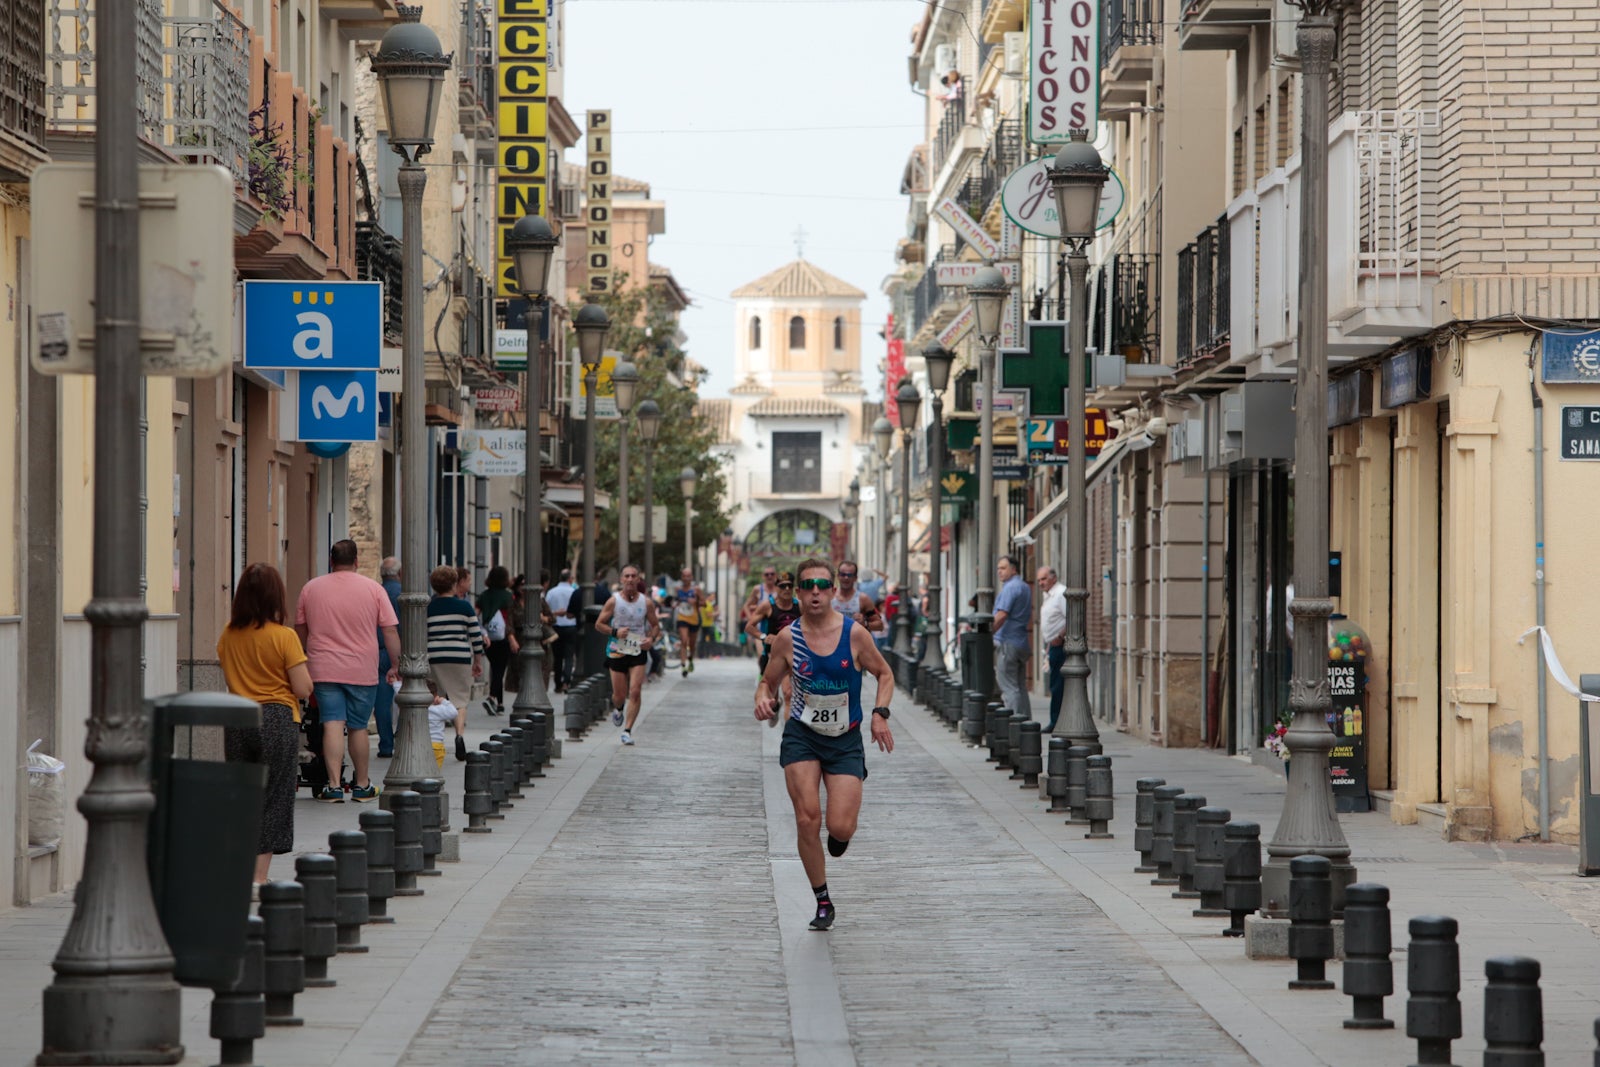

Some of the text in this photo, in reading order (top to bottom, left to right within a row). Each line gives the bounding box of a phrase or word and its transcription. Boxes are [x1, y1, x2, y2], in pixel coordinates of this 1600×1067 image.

[1037, 0, 1059, 131] TICOS
[1068, 1, 1092, 129] ONOS
[504, 0, 540, 294] ECCION
[590, 113, 608, 291] PIONONOS
[1059, 439, 1105, 448] TCO
[623, 640, 638, 648] 714
[811, 708, 838, 723] 281
